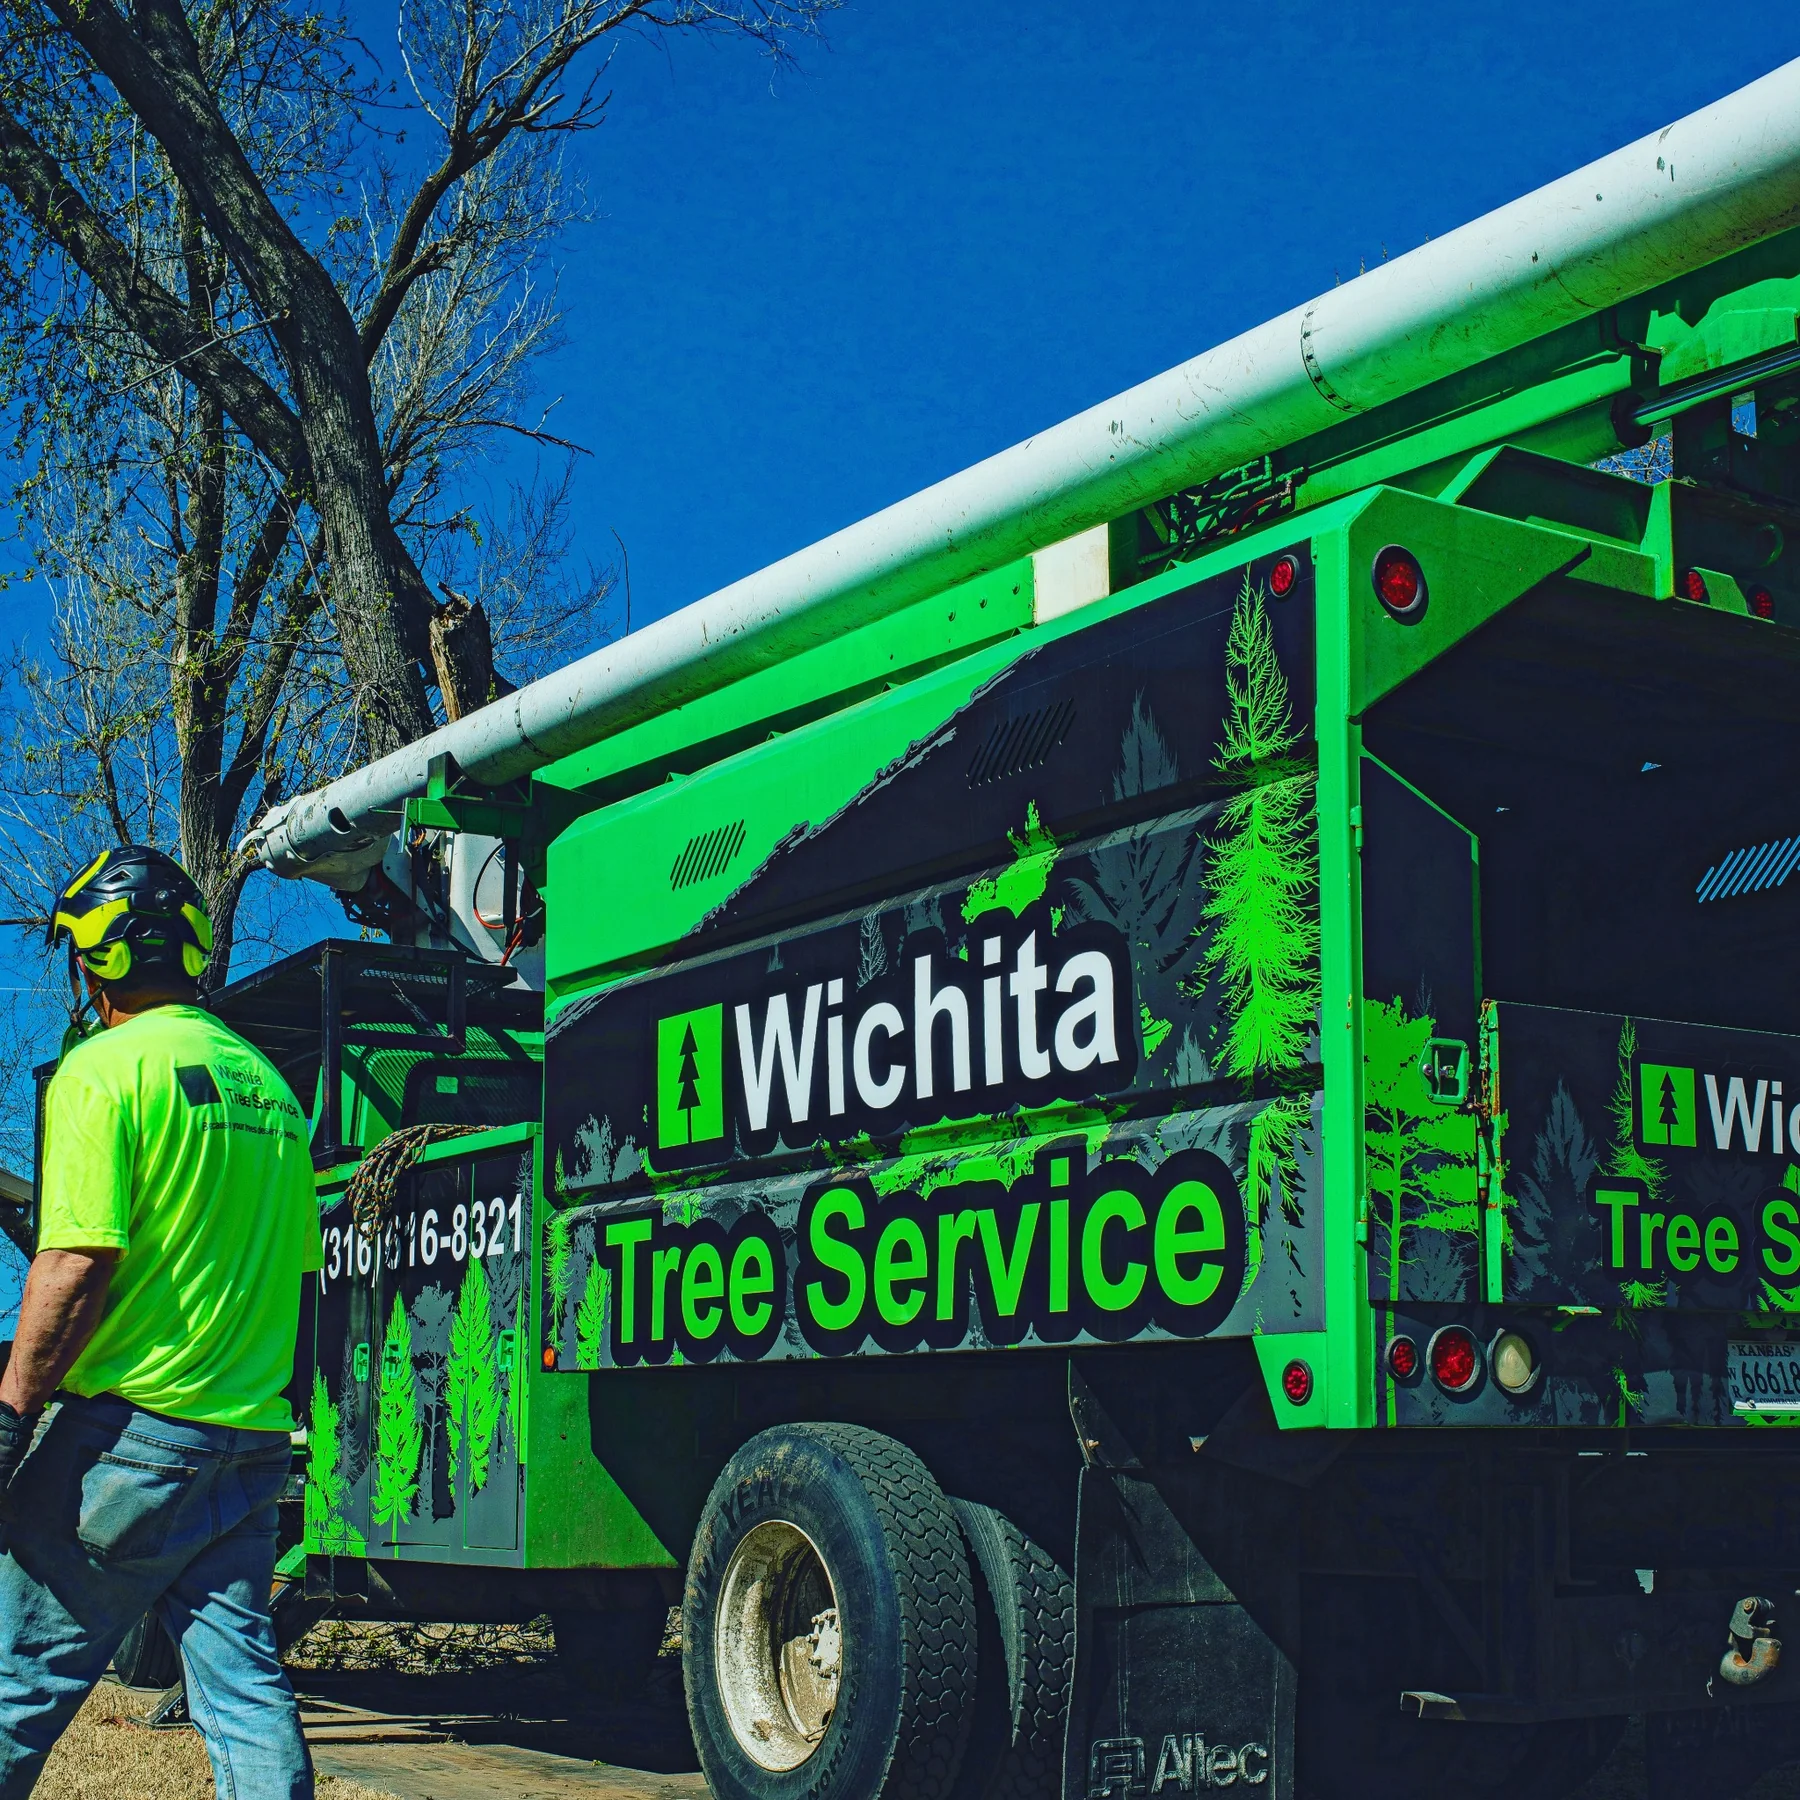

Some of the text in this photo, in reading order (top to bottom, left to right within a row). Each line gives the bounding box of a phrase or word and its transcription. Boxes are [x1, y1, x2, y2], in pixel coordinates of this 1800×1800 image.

[734, 929, 1119, 1132] Wichita
[213, 1063, 264, 1087] Wichita
[224, 1087, 300, 1119] Tree Service
[605, 1157, 1226, 1344] Tree Service
[1596, 1190, 1740, 1274] Tree
[1735, 1344, 1791, 1357] KANSAS
[1741, 1360, 1800, 1395] 66618
[1151, 1732, 1268, 1795] Altec
